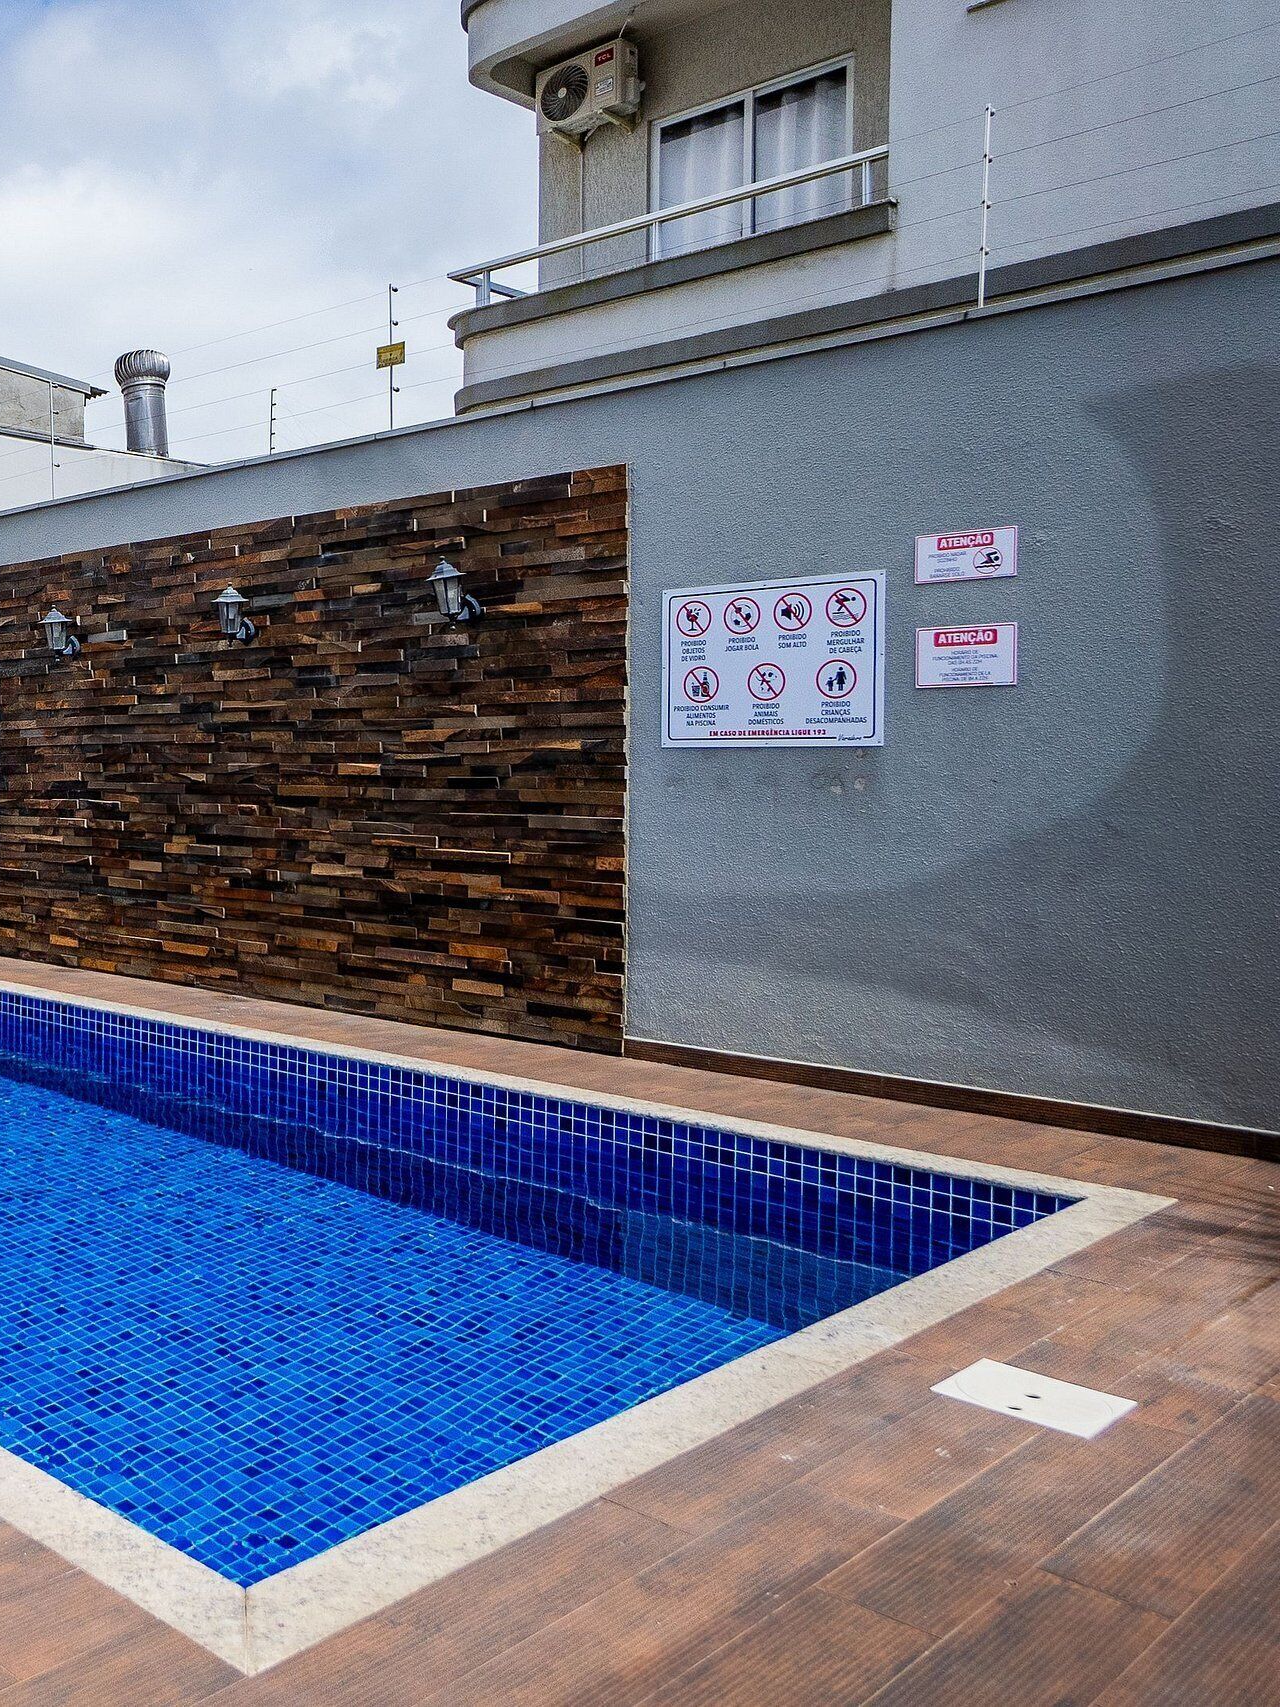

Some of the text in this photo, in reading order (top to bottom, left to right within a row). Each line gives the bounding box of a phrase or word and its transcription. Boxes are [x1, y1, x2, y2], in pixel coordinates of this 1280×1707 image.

[598, 53, 611, 62] TCL
[940, 533, 991, 548] ATENÇÃO
[728, 636, 756, 644] PROIBIDO
[778, 633, 807, 641] PROIBIDO
[938, 630, 993, 644] ATENÇÃO
[681, 639, 706, 647] PROIBIDO
[827, 638, 865, 646] MERGULHAR
[838, 646, 862, 654] CABEÇA
[805, 716, 867, 724] DESACOMPANHADAS
